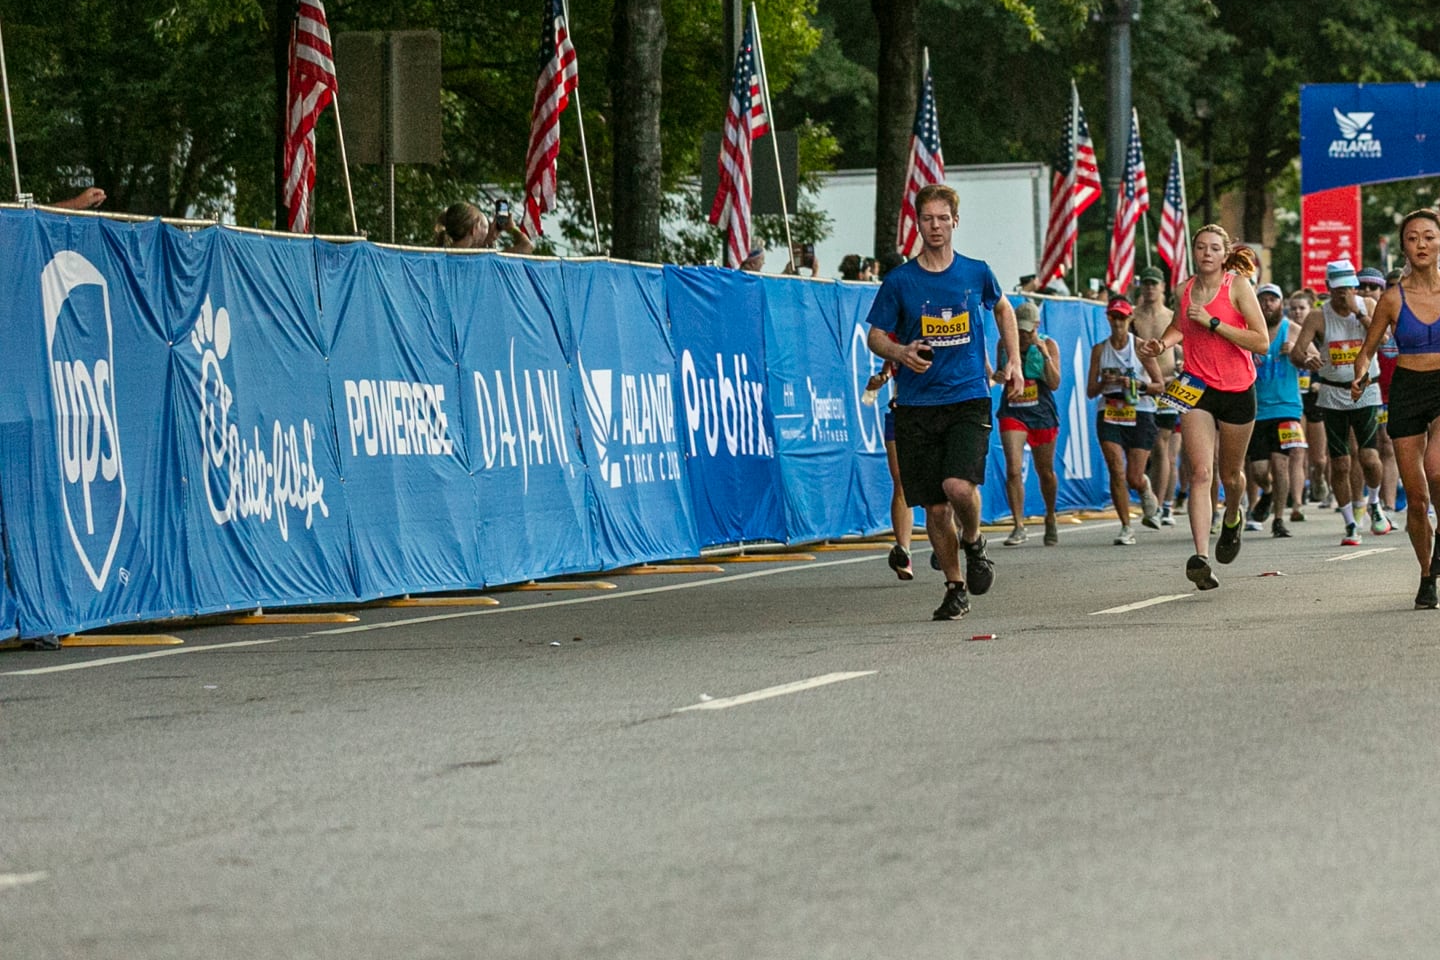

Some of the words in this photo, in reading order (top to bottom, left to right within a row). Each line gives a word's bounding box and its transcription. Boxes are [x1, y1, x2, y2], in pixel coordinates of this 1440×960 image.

[1328, 139, 1382, 153] ATLANTA
[926, 322, 967, 334] D20581
[344, 378, 454, 457] POWERADE
[474, 337, 572, 495] DASANI
[621, 372, 677, 445] ATLANTA
[681, 349, 770, 457] Publix
[55, 359, 119, 535] ups
